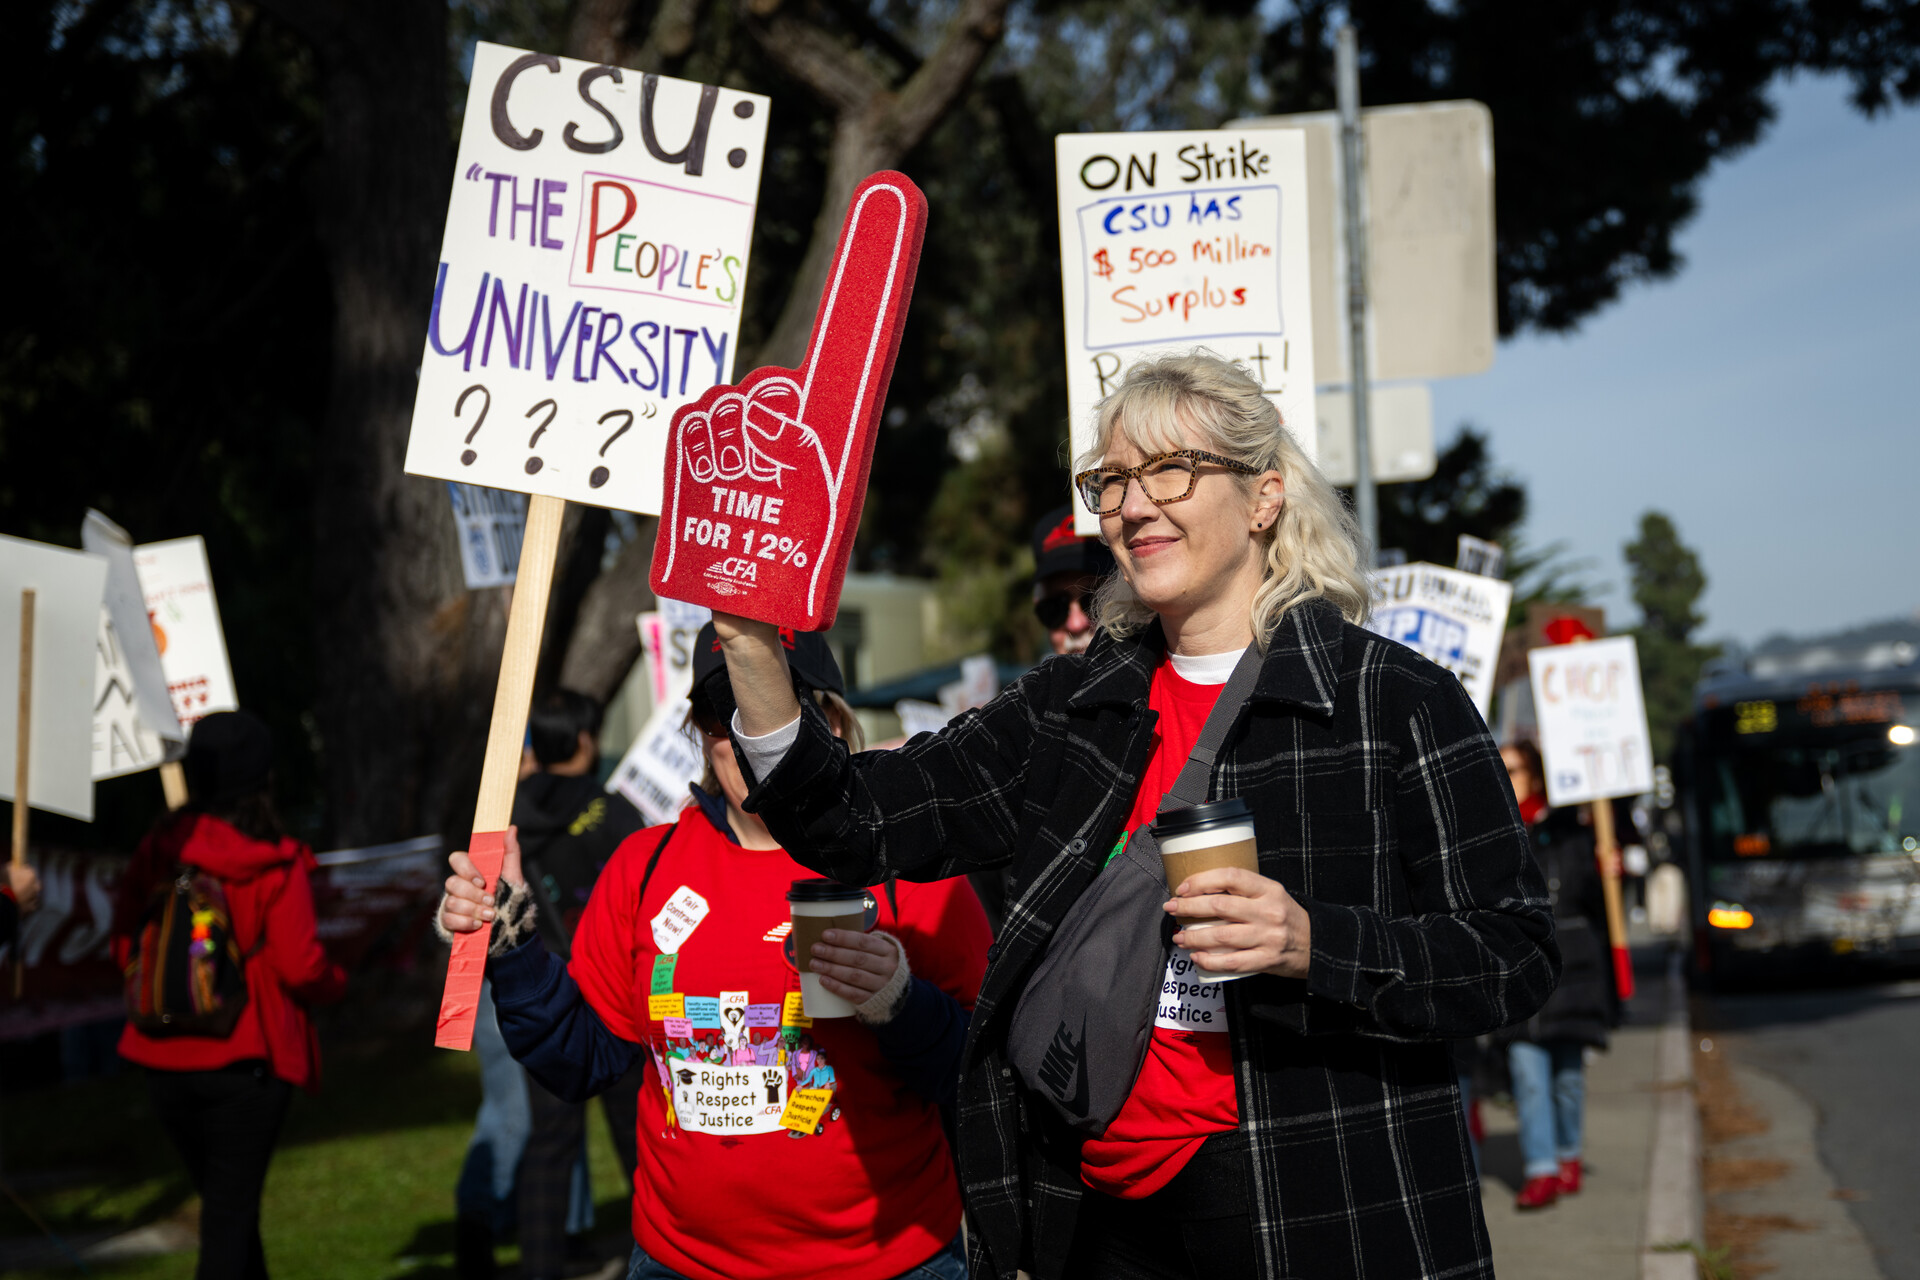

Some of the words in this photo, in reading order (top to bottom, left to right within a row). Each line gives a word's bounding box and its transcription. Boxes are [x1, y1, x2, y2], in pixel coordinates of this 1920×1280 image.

[490, 51, 754, 176] CSU:
[1080, 152, 1157, 192] ON
[1177, 139, 1271, 184] Strike
[1103, 204, 1171, 235] CSU
[1129, 247, 1176, 273] 500
[1111, 277, 1247, 323] Surplus
[427, 262, 728, 399] UNIVERSITY
[711, 486, 784, 525] TIME
[683, 516, 731, 550] FOR
[742, 529, 808, 568] 12%
[722, 557, 757, 582] CFA
[1374, 571, 1415, 603] SU
[666, 902, 697, 927] Contract
[682, 896, 699, 911] Fair
[662, 917, 684, 936] Now!
[729, 995, 745, 1004] CFA
[1162, 980, 1221, 1001] espect
[1157, 1002, 1213, 1023] ustice
[1038, 1020, 1080, 1100] NIKE
[701, 1071, 749, 1090] Rights
[696, 1091, 756, 1111] Respect
[765, 1105, 781, 1115] CFA
[791, 1101, 817, 1113] Respeto
[699, 1112, 753, 1127] Justice
